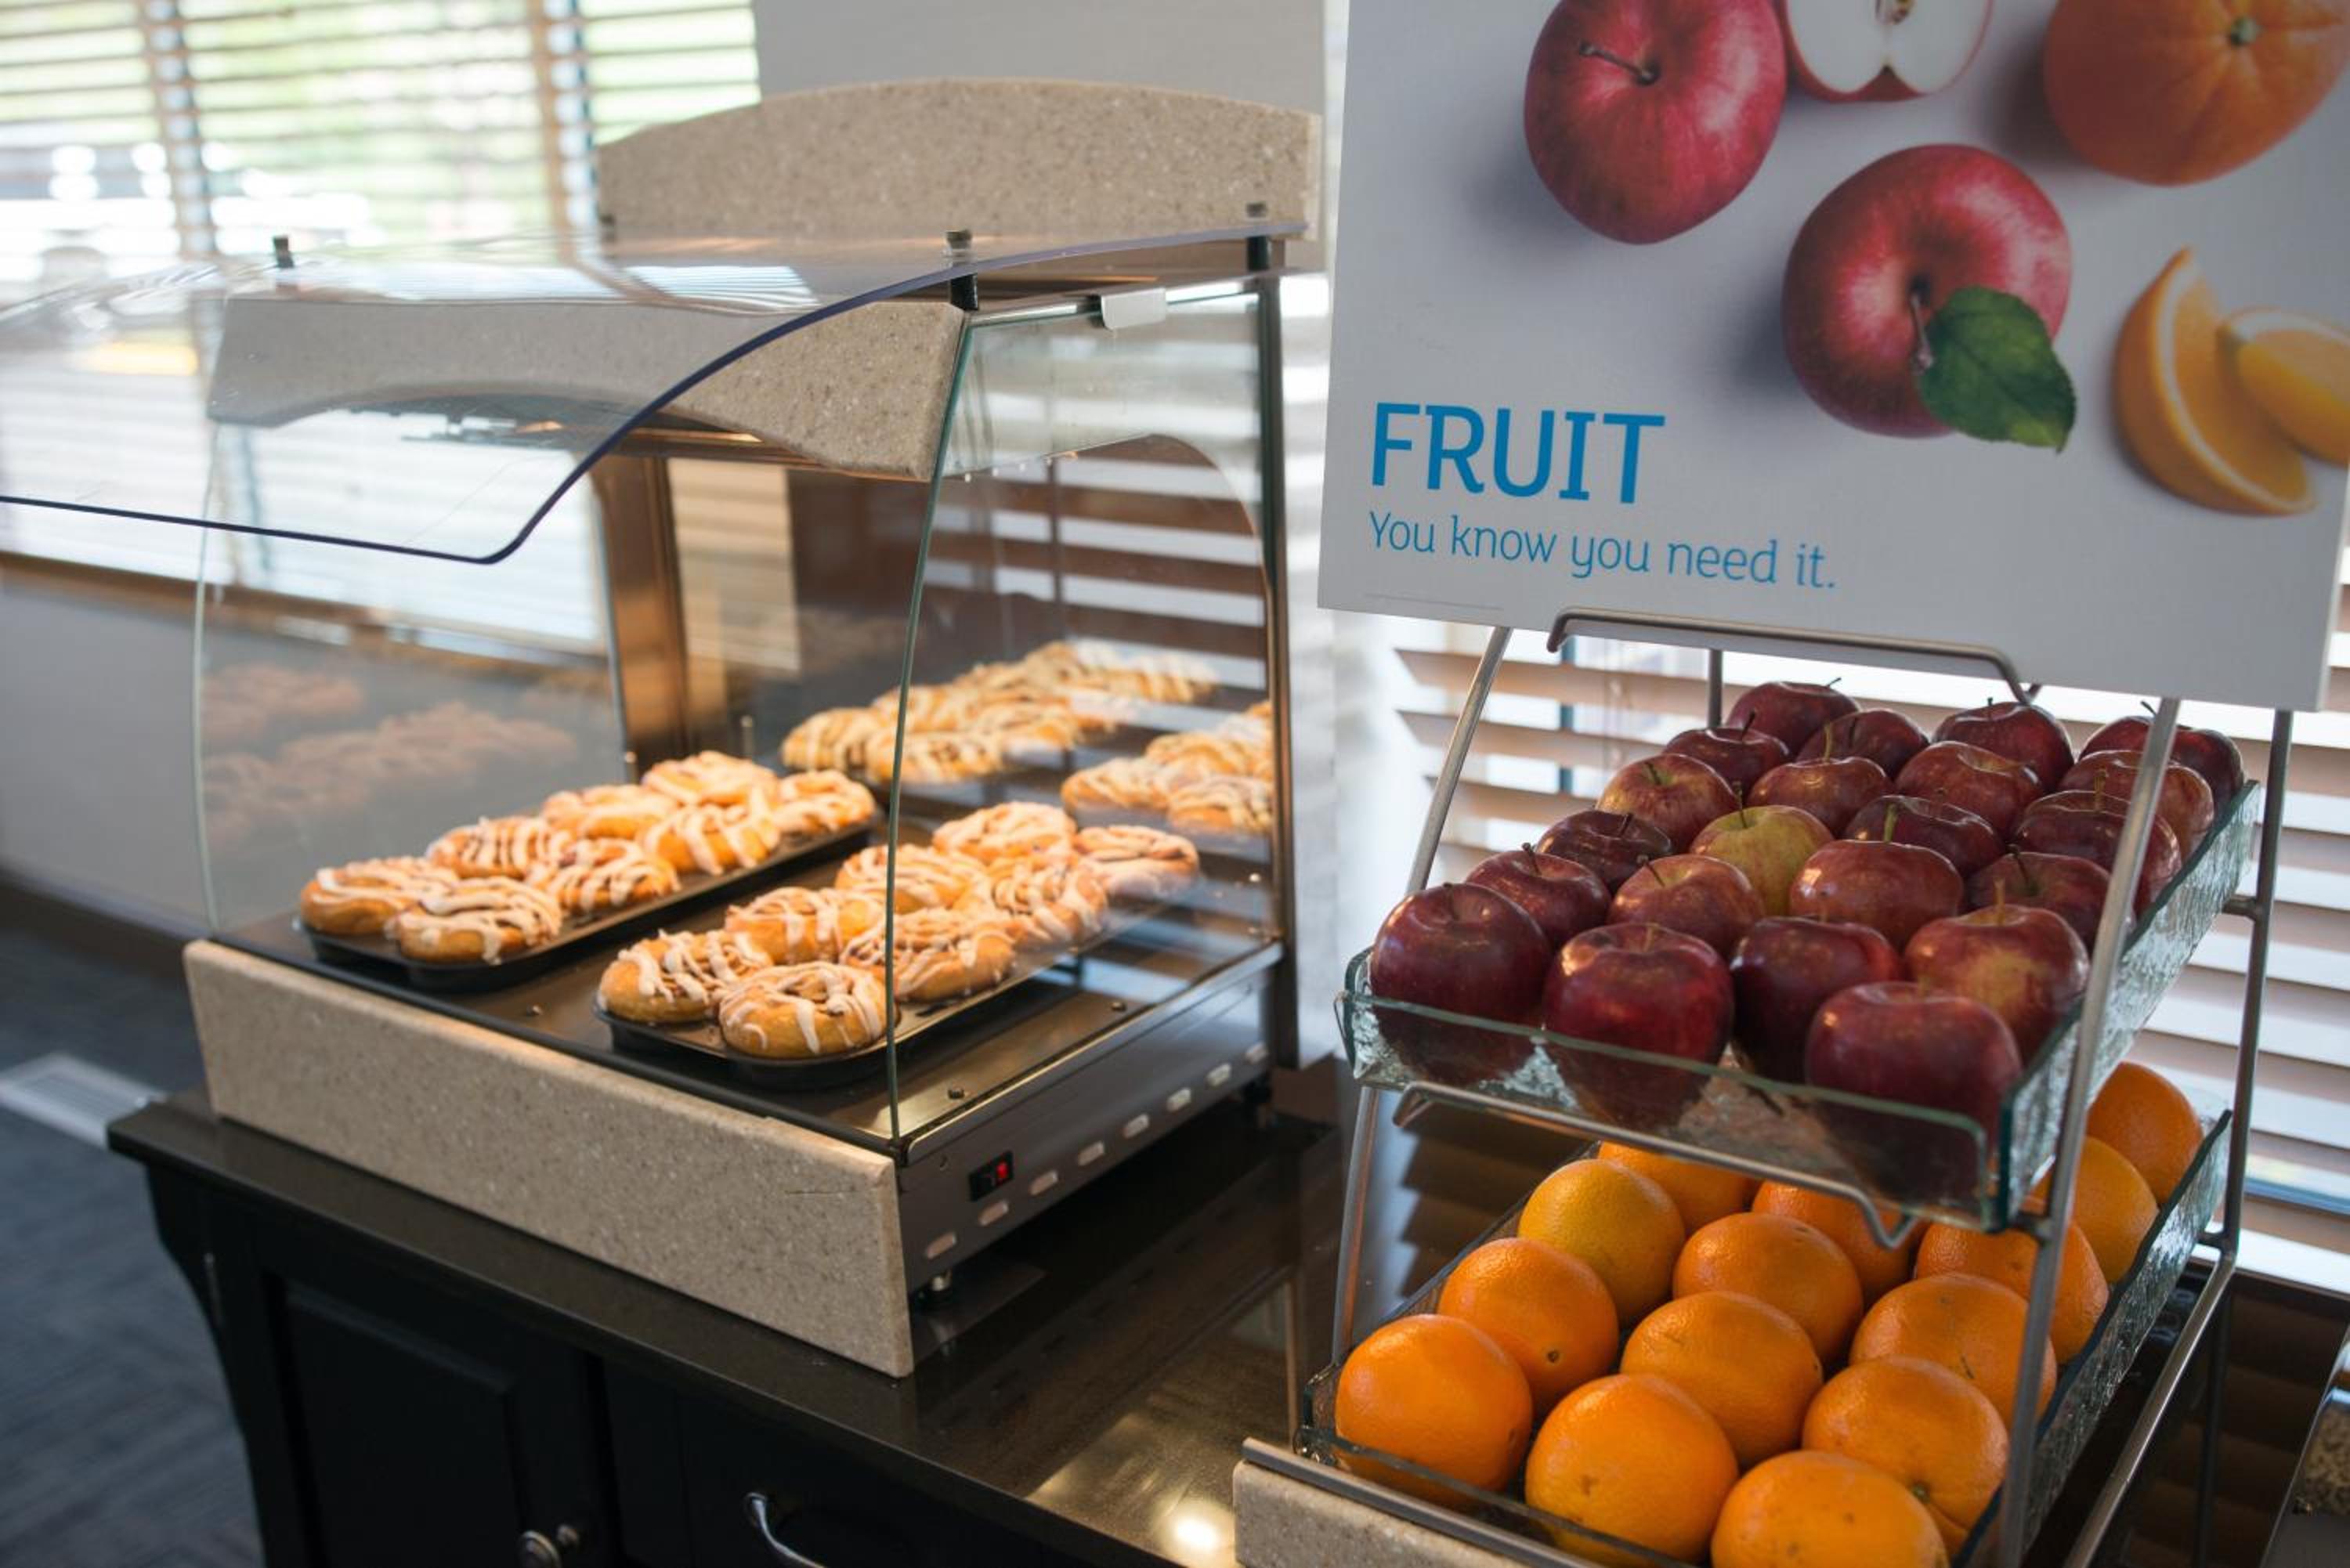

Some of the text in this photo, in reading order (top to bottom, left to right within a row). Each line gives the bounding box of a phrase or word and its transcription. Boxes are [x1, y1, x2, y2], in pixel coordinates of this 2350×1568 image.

[1371, 400, 1667, 505] FRUIT
[1370, 511, 1836, 589] You know you need it.
